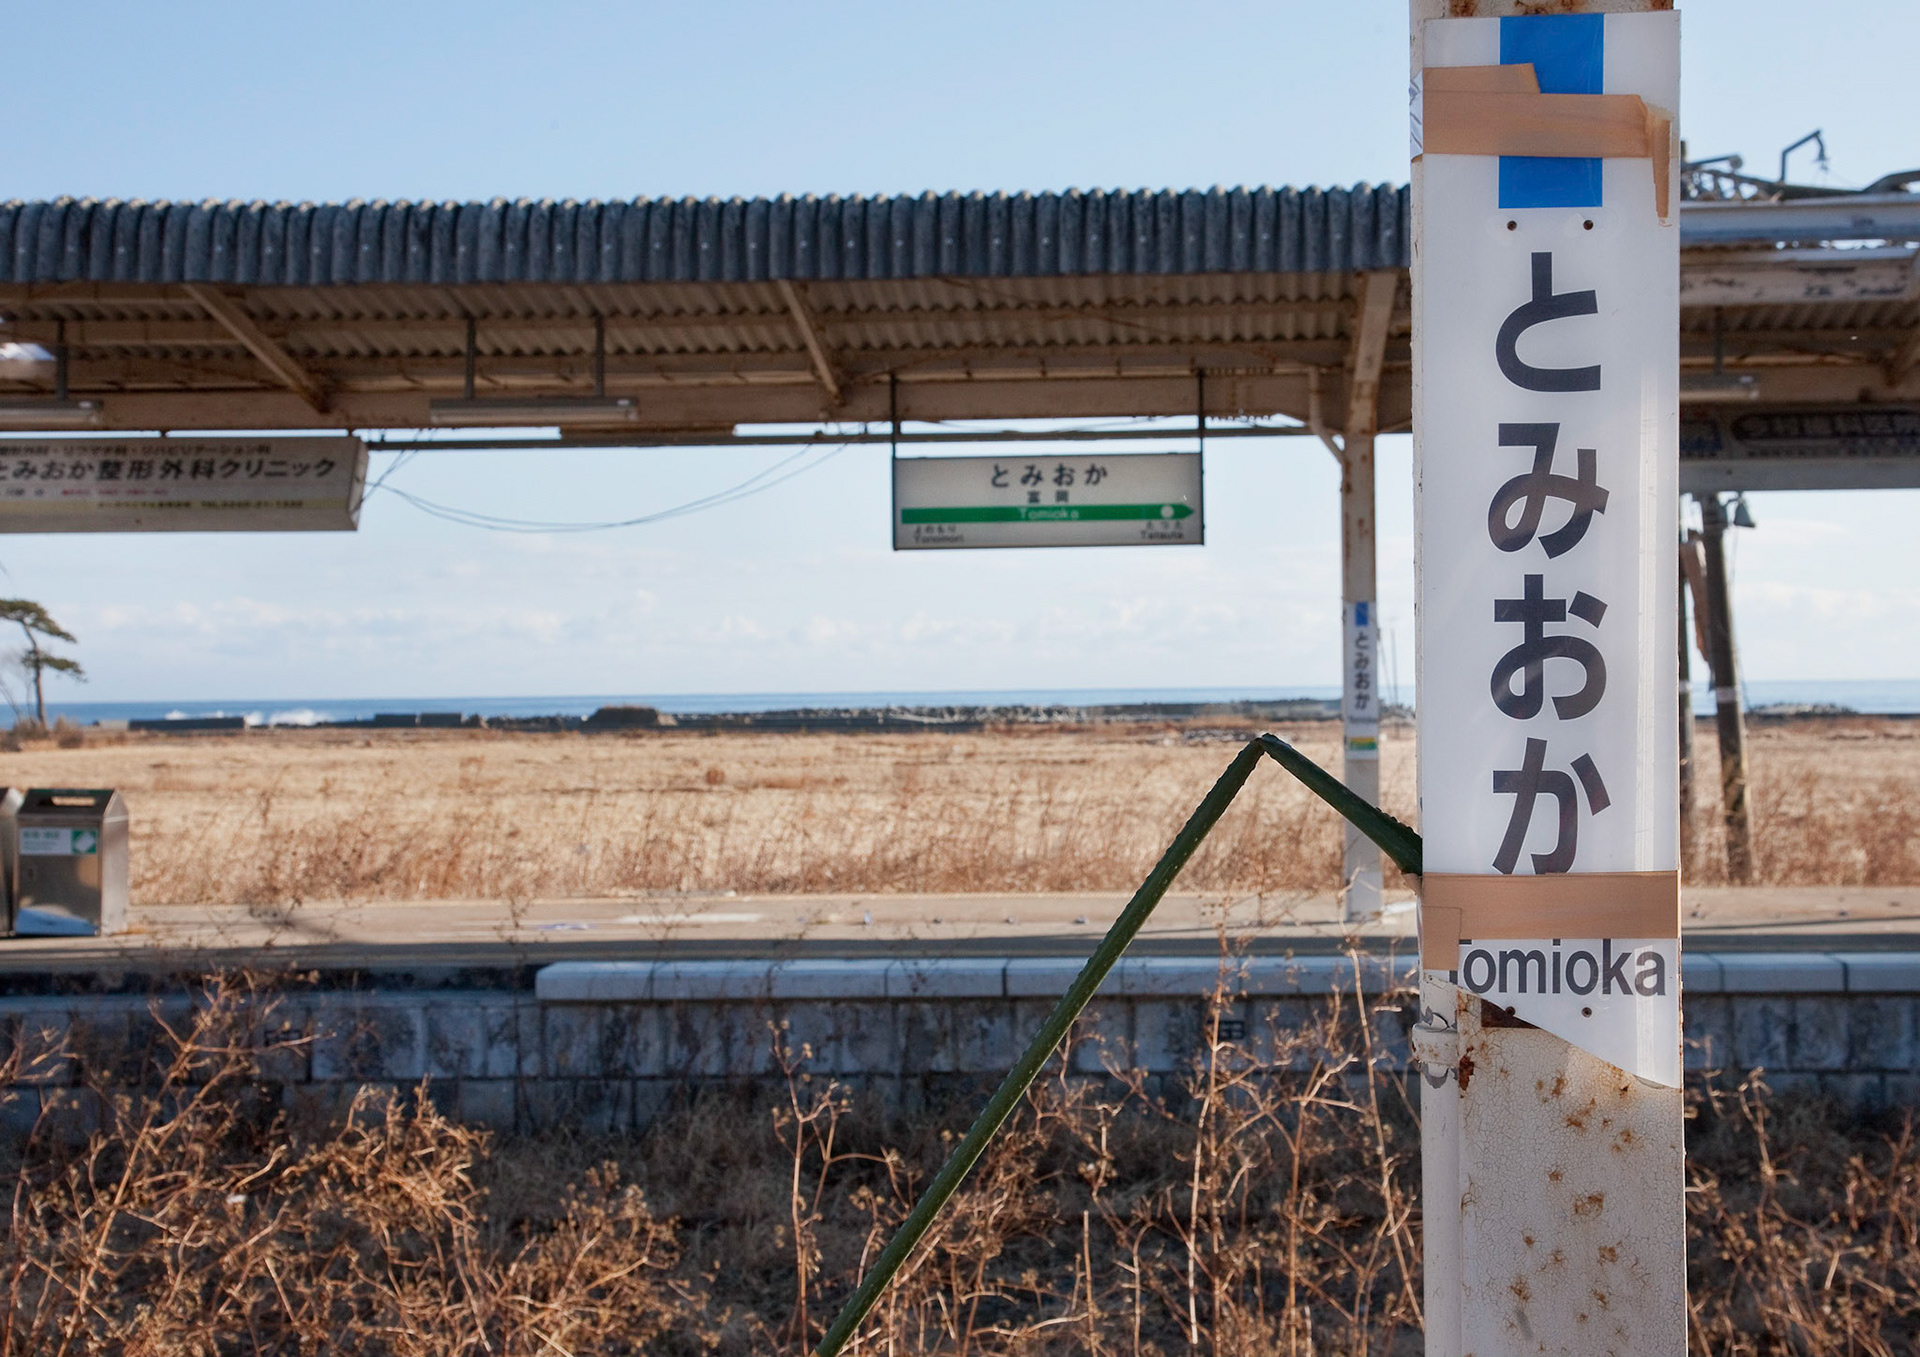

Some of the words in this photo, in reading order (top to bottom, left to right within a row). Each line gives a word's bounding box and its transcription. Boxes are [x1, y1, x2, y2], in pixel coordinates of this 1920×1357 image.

[991, 463, 1108, 488] とみおか
[1018, 507, 1080, 520] Tomioka
[1487, 252, 1611, 874] とみおか
[1354, 632, 1371, 710] とみおか
[1449, 939, 1667, 996] omioka
